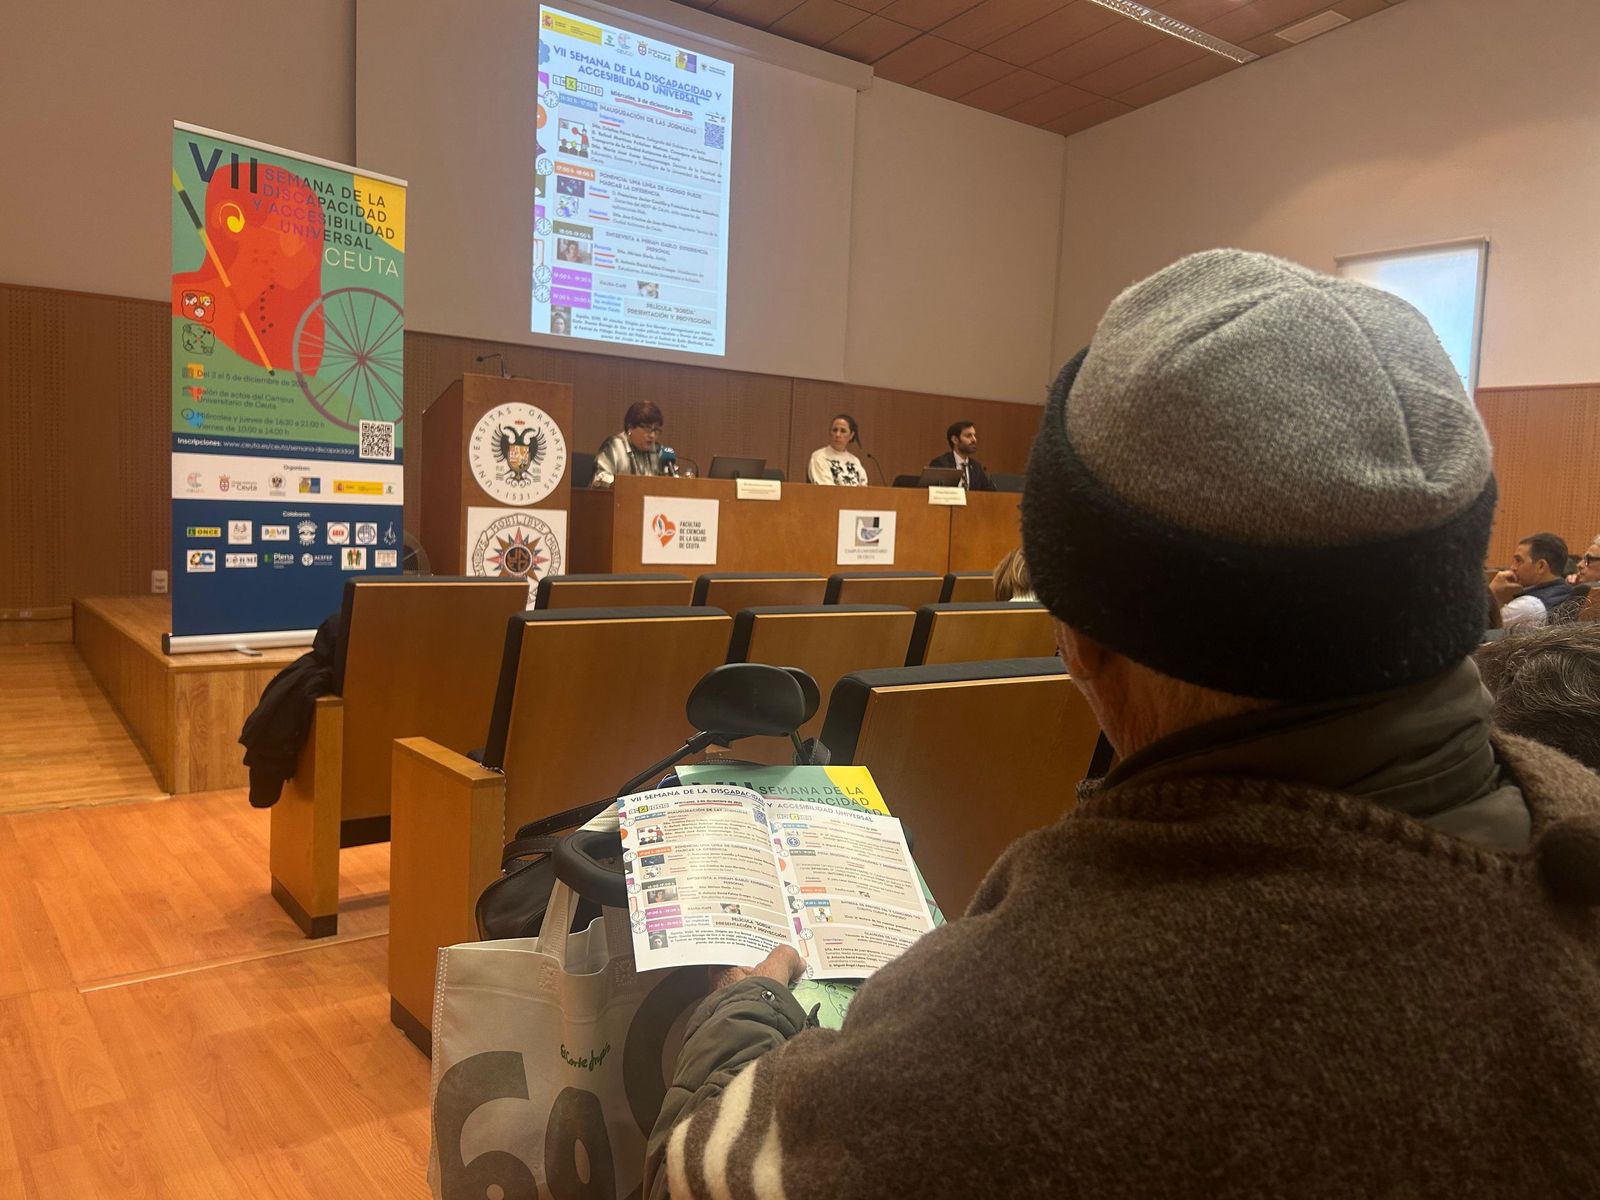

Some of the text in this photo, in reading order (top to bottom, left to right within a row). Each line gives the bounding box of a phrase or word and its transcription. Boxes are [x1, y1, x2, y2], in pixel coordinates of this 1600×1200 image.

[553, 45, 566, 57] VII
[570, 50, 609, 69] SEMANA
[614, 62, 626, 74] DE
[630, 67, 641, 78] LA
[644, 71, 712, 98] DISCAPACIDAD
[715, 92, 721, 101] Y
[578, 63, 700, 106] ACCESIBILIDAD UNIVERSAL
[188, 142, 258, 194] VII
[262, 183, 387, 222] DISCAPACIDAD
[265, 168, 386, 208] SEMANA DE LA
[252, 200, 395, 240] Y ACCESIBILIDAD
[280, 222, 372, 250] UNIVERSAL
[324, 247, 399, 278] CEUTA
[243, 374, 279, 385] diciembre
[178, 437, 221, 447] Inscripciones:
[474, 407, 512, 487] UNIVERSITAS
[528, 409, 563, 490] GRANATENSIS
[644, 791, 680, 800] SEMANA
[759, 786, 820, 795] SEMANA
[778, 803, 833, 814] ACCESIBILIDAD
[836, 810, 874, 822] UNIVERSAL
